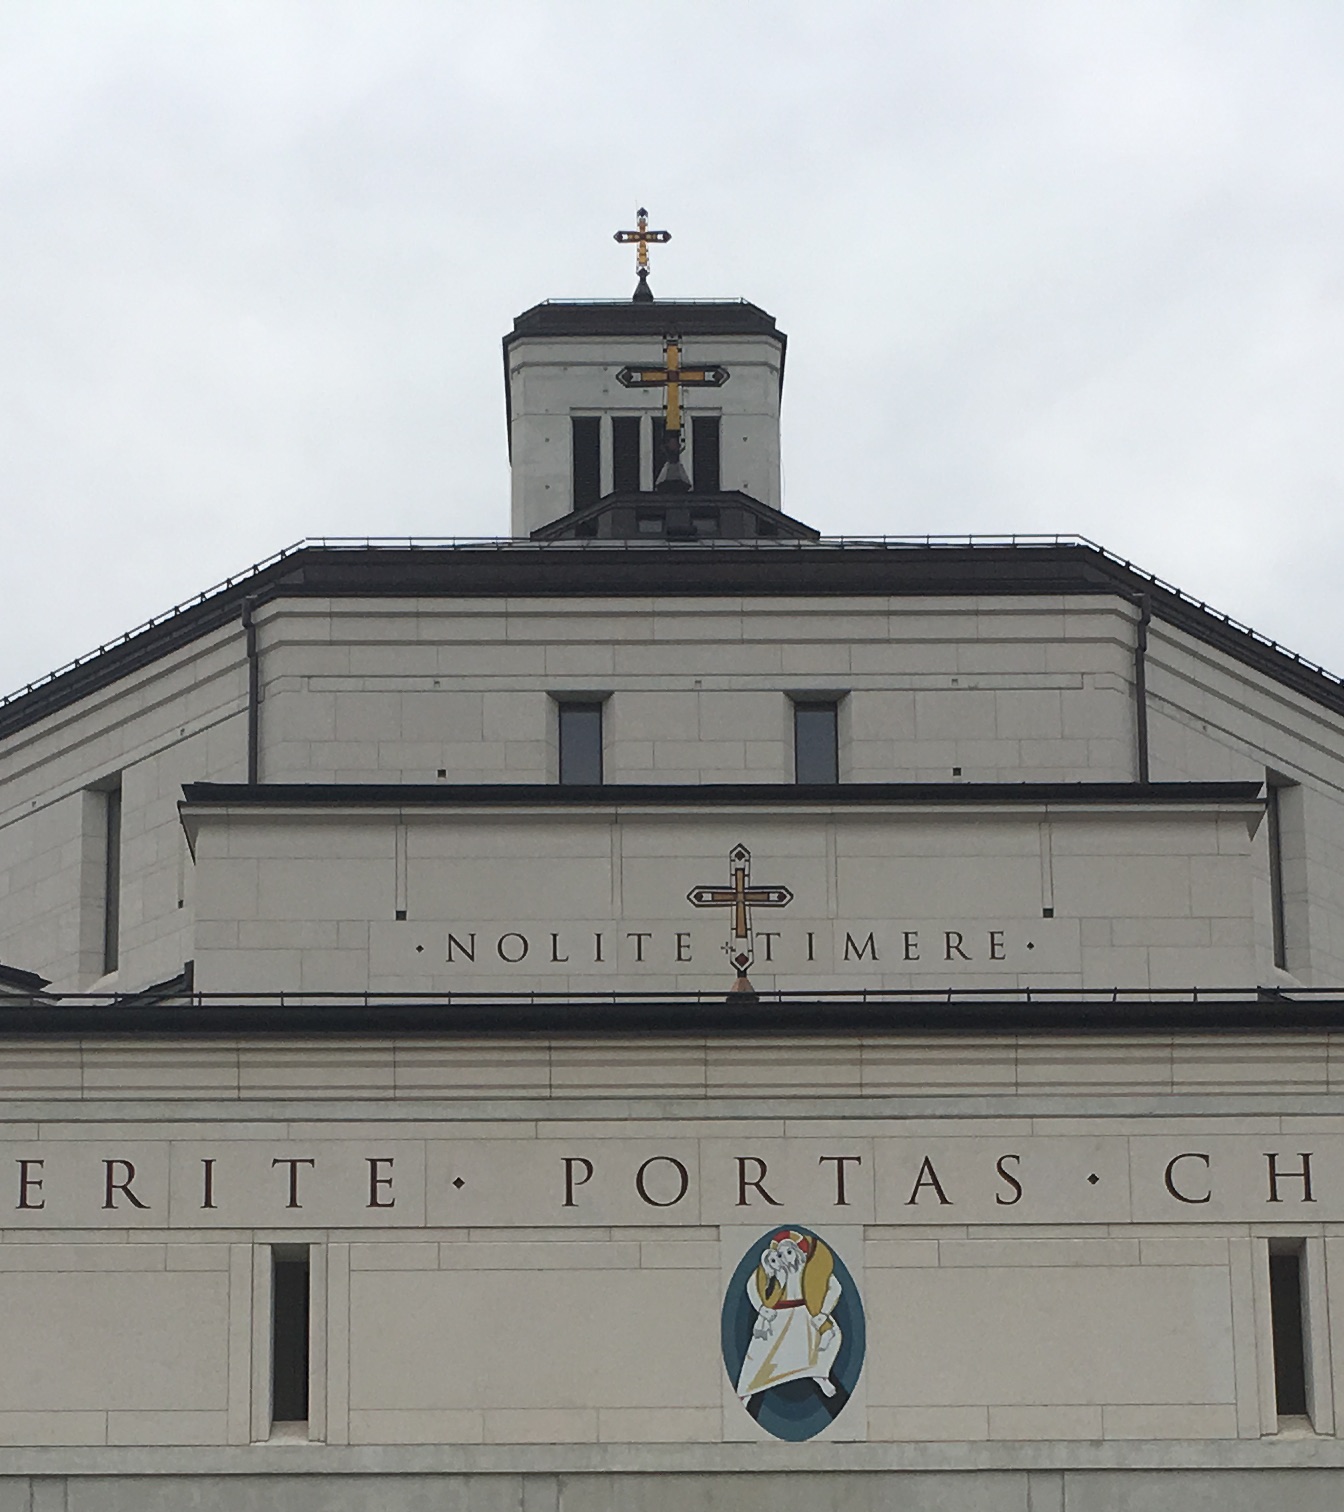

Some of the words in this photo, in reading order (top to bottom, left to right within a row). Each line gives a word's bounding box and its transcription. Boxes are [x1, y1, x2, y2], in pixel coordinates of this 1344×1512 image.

[445, 931, 693, 963] NOLITE
[755, 930, 1007, 962] TIMERE
[559, 1154, 1024, 1207] PORTAS
